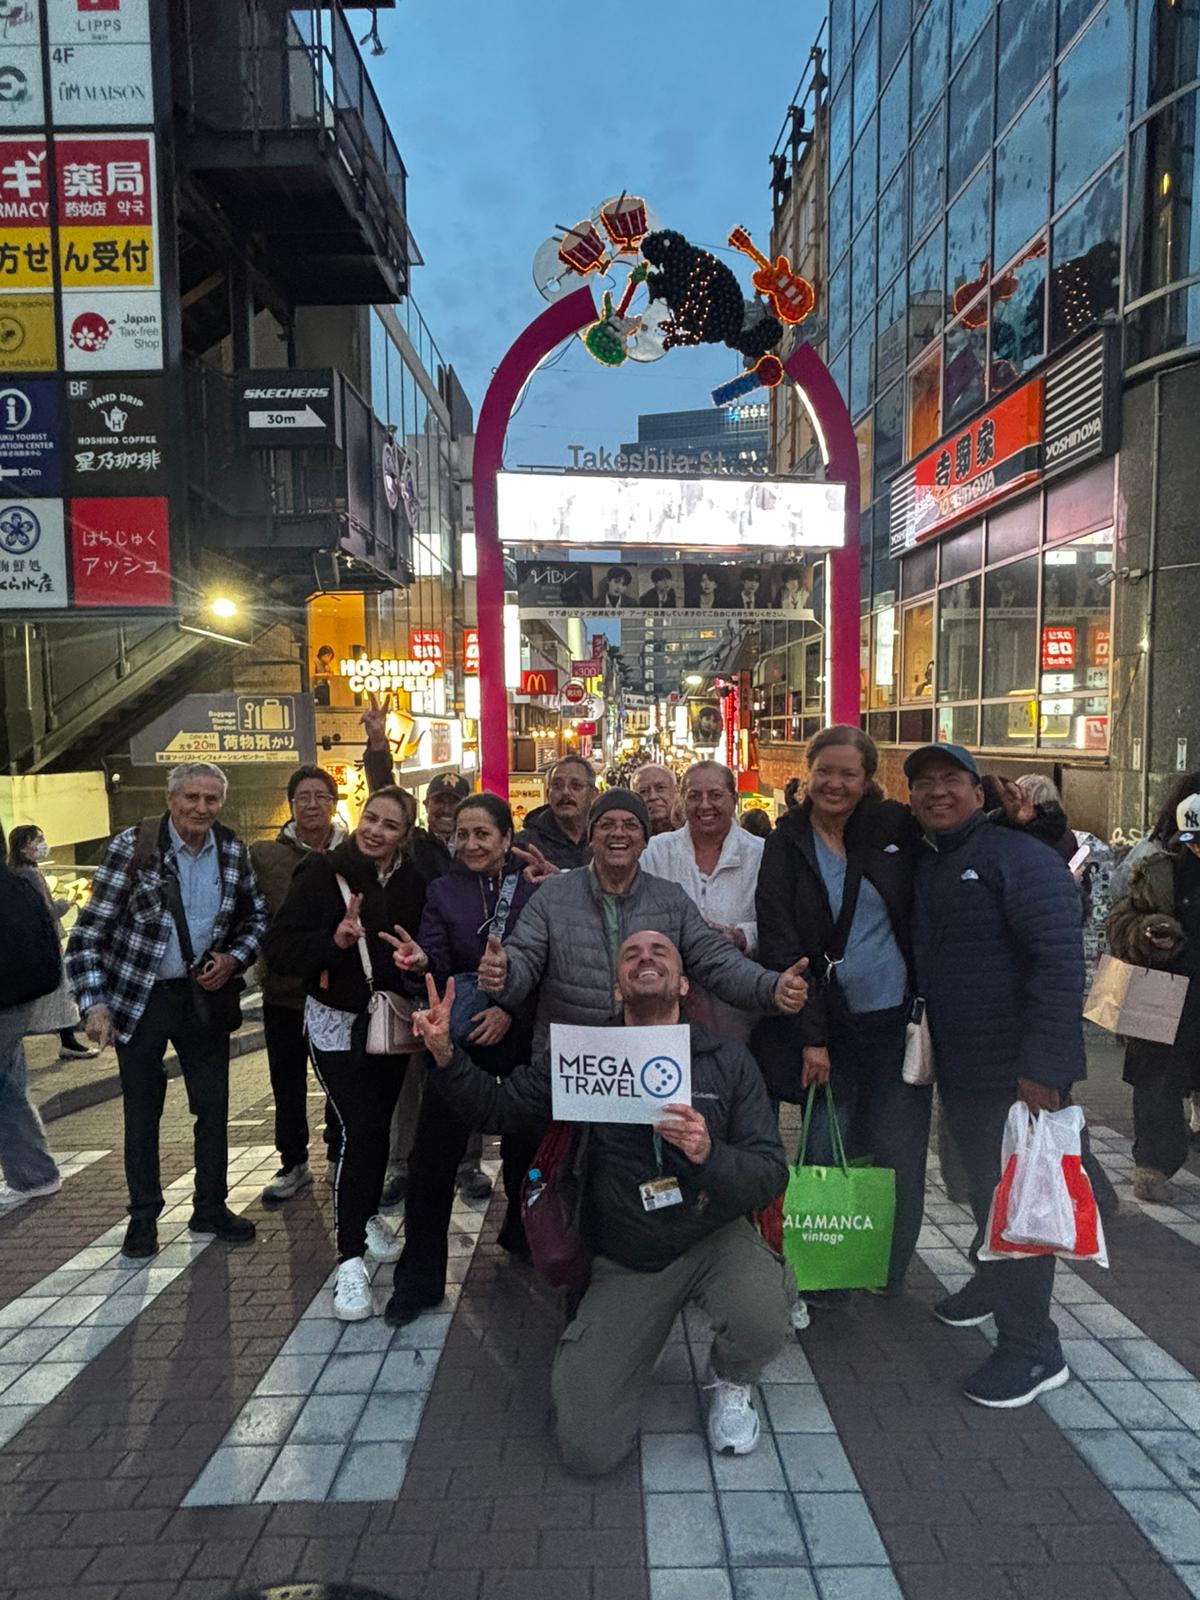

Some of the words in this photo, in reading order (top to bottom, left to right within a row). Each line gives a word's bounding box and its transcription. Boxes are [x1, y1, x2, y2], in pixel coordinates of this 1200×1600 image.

[78, 19, 121, 31] LIPPS
[52, 48, 74, 63] 4F
[63, 160, 144, 197] 薬局
[123, 312, 156, 324] Japan
[119, 326, 159, 337] Tax-free
[134, 337, 160, 349] Shop
[69, 381, 88, 396] BF
[243, 388, 330, 399] SKECHERS
[88, 393, 117, 409] HAND
[120, 393, 144, 407] DRIP
[267, 414, 296, 424] 30m
[16, 433, 47, 441] TOURIST
[77, 436, 119, 445] HOSHINO
[121, 435, 157, 443] COFFEE
[568, 444, 690, 474] Takeshita
[21, 468, 41, 477] 20m
[82, 529, 157, 547] はらじゅく
[82, 556, 161, 576] アッシュ
[339, 658, 436, 677] HOSHINO
[348, 675, 431, 693] COFFEE
[208, 710, 236, 718] Baggage
[223, 734, 295, 751] 荷物預かり
[559, 1053, 635, 1077] MEGA
[559, 1075, 642, 1098] TRAVEL
[783, 1214, 874, 1231] ALAMANCA
[801, 1231, 845, 1244] vintage
